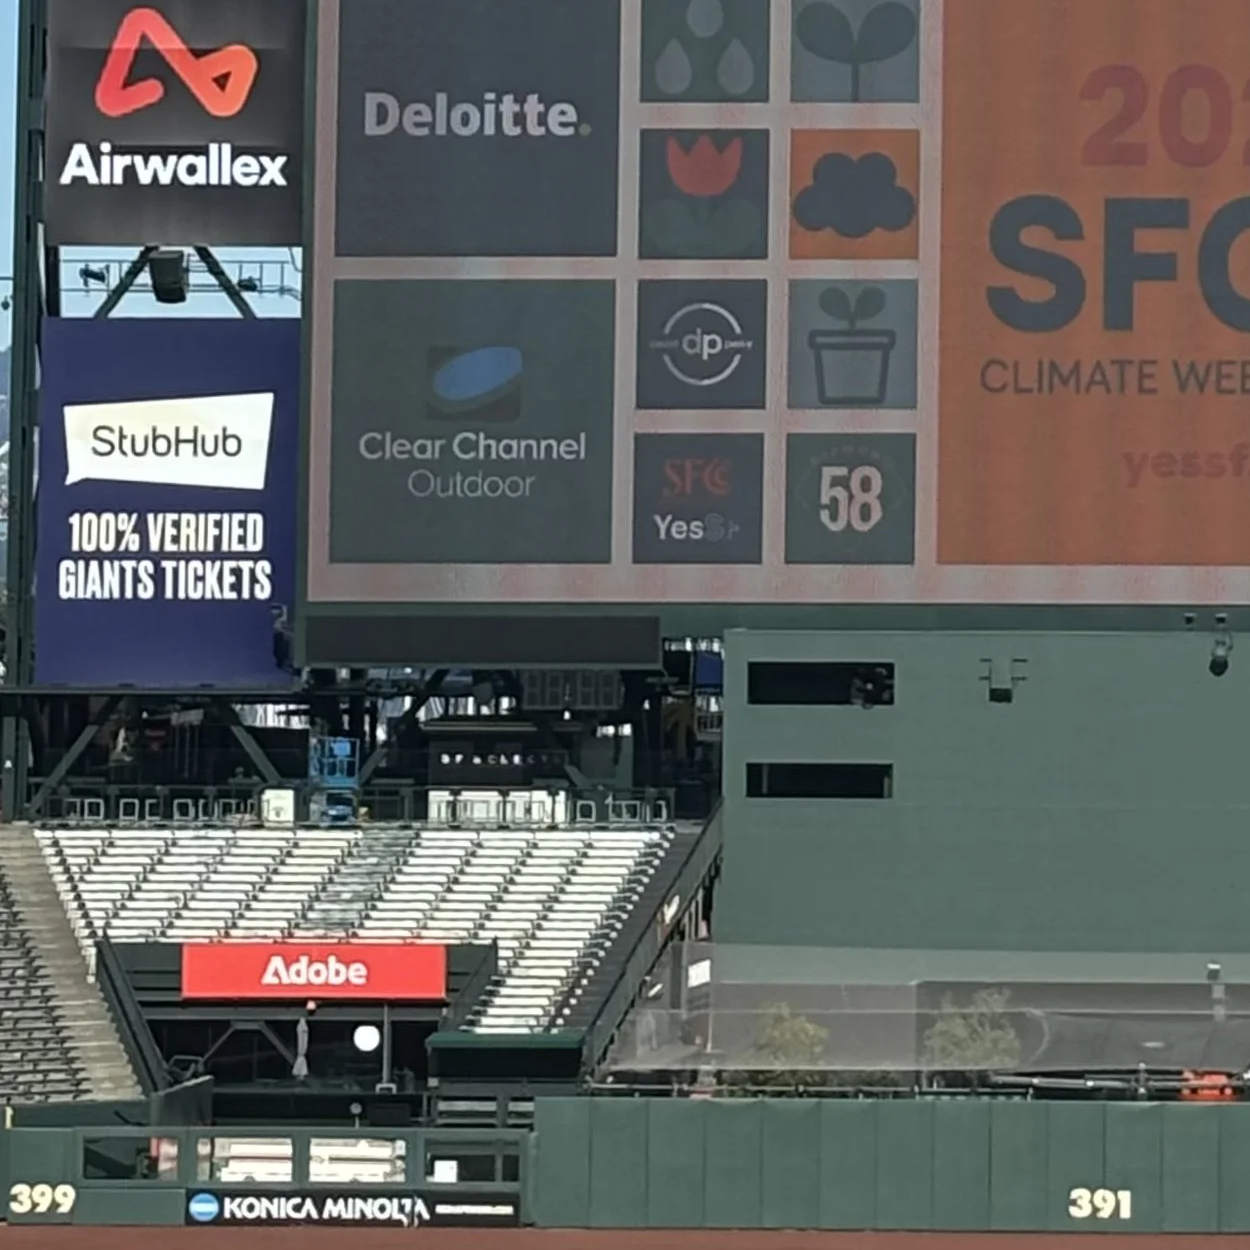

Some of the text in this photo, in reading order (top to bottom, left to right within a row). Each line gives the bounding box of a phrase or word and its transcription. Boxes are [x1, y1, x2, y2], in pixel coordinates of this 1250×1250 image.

[59, 143, 287, 187] Airwallex
[682, 327, 722, 360] dp
[980, 358, 1158, 396] CLIMATE
[91, 425, 242, 458] StubHub
[359, 431, 586, 462] Clear Channel
[408, 469, 534, 498] Outdoor
[820, 466, 883, 532] 58
[68, 513, 263, 553] 100% VERIFIED
[58, 560, 271, 601] GIANTS TICKETS
[261, 954, 367, 985] Adobe
[9, 1183, 76, 1214] 399
[224, 1197, 317, 1220] KONICA
[1068, 1188, 1131, 1220] 391
